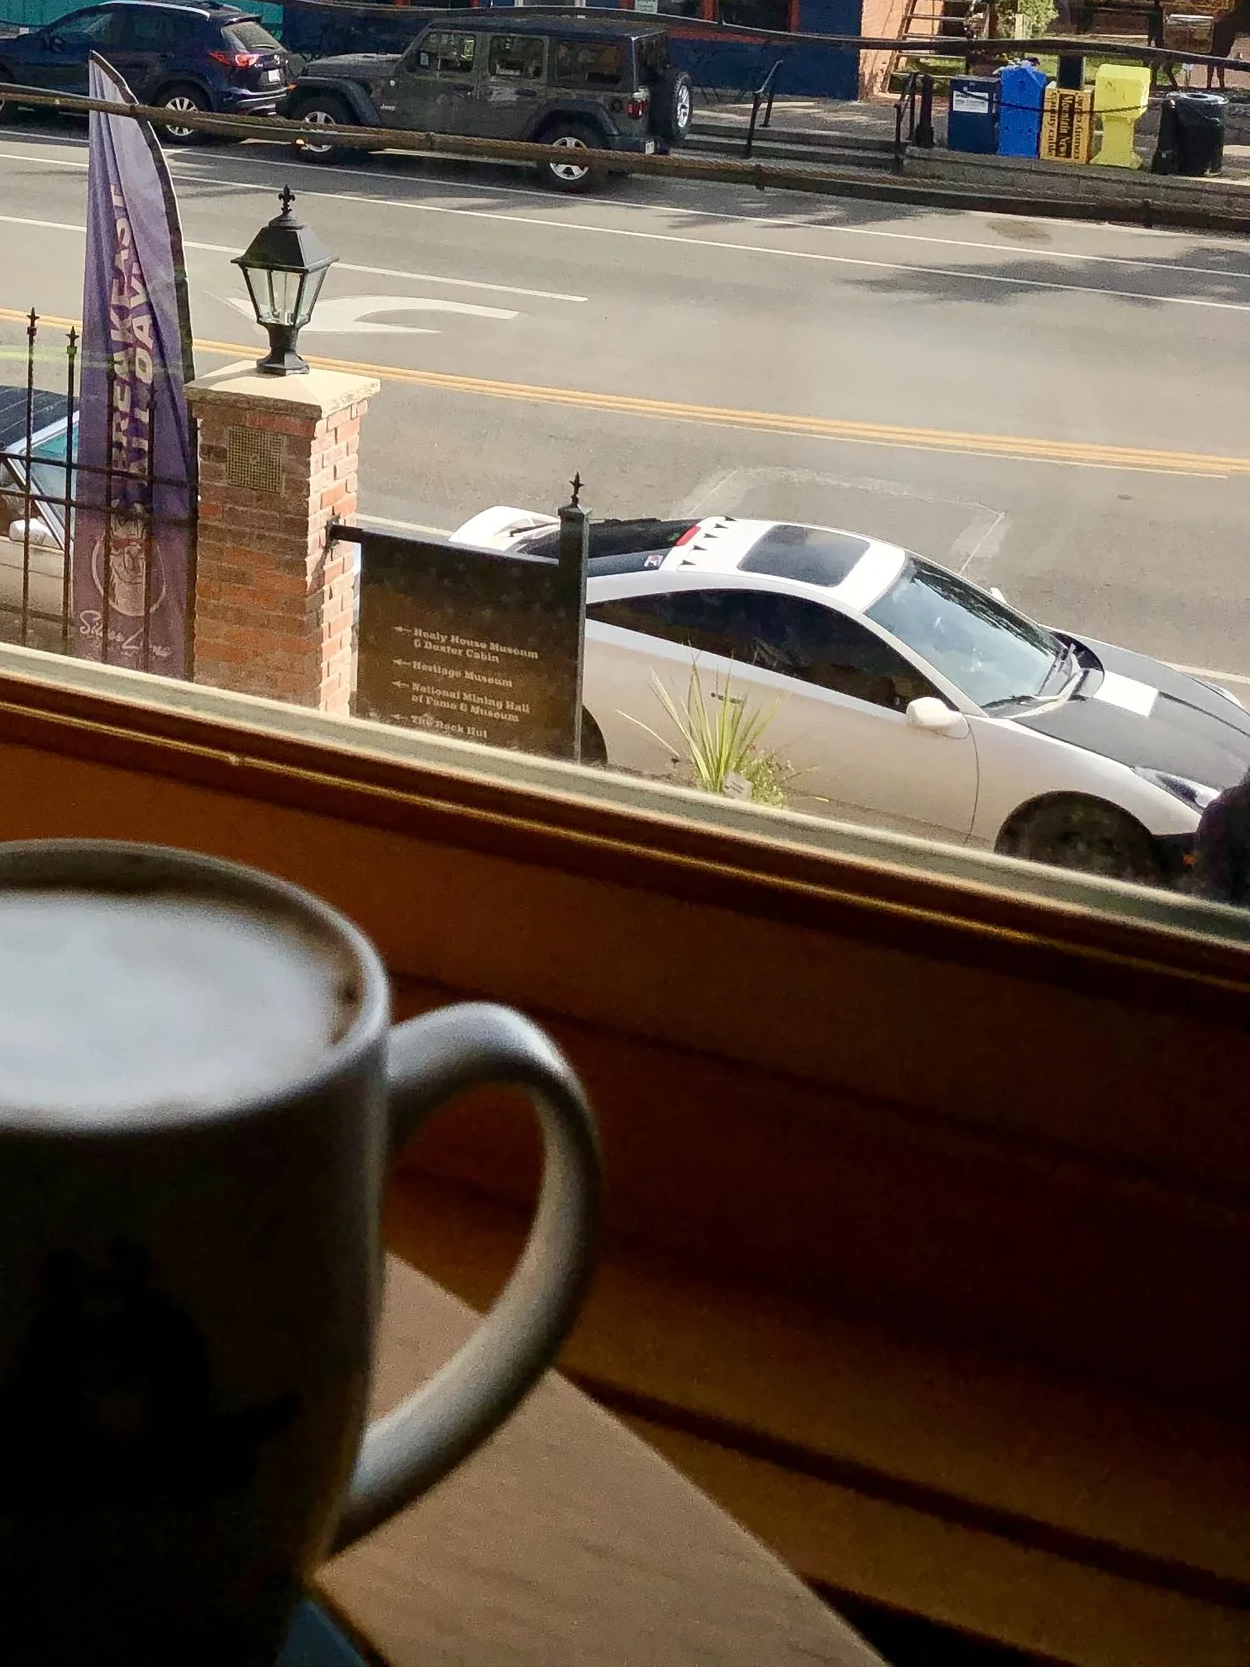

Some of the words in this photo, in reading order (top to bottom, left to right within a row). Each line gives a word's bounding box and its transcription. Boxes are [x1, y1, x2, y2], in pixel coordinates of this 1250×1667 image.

[79, 610, 125, 642] Siler
[413, 628, 448, 643] Healy
[450, 635, 487, 649] House
[490, 642, 539, 659] Museum
[413, 639, 422, 650] &
[424, 640, 463, 656] Dexter
[466, 649, 500, 663] Cabin
[412, 660, 462, 678] Heritage
[464, 670, 513, 688] Museum
[412, 682, 461, 700] National
[462, 692, 503, 709] Mining
[505, 701, 531, 714] Hall
[412, 695, 424, 704] of
[425, 696, 458, 710] Fame
[460, 702, 468, 713] &
[470, 705, 520, 722] Museum
[411, 715, 433, 727] The
[435, 719, 464, 733] Rock
[466, 726, 488, 739] Hut
